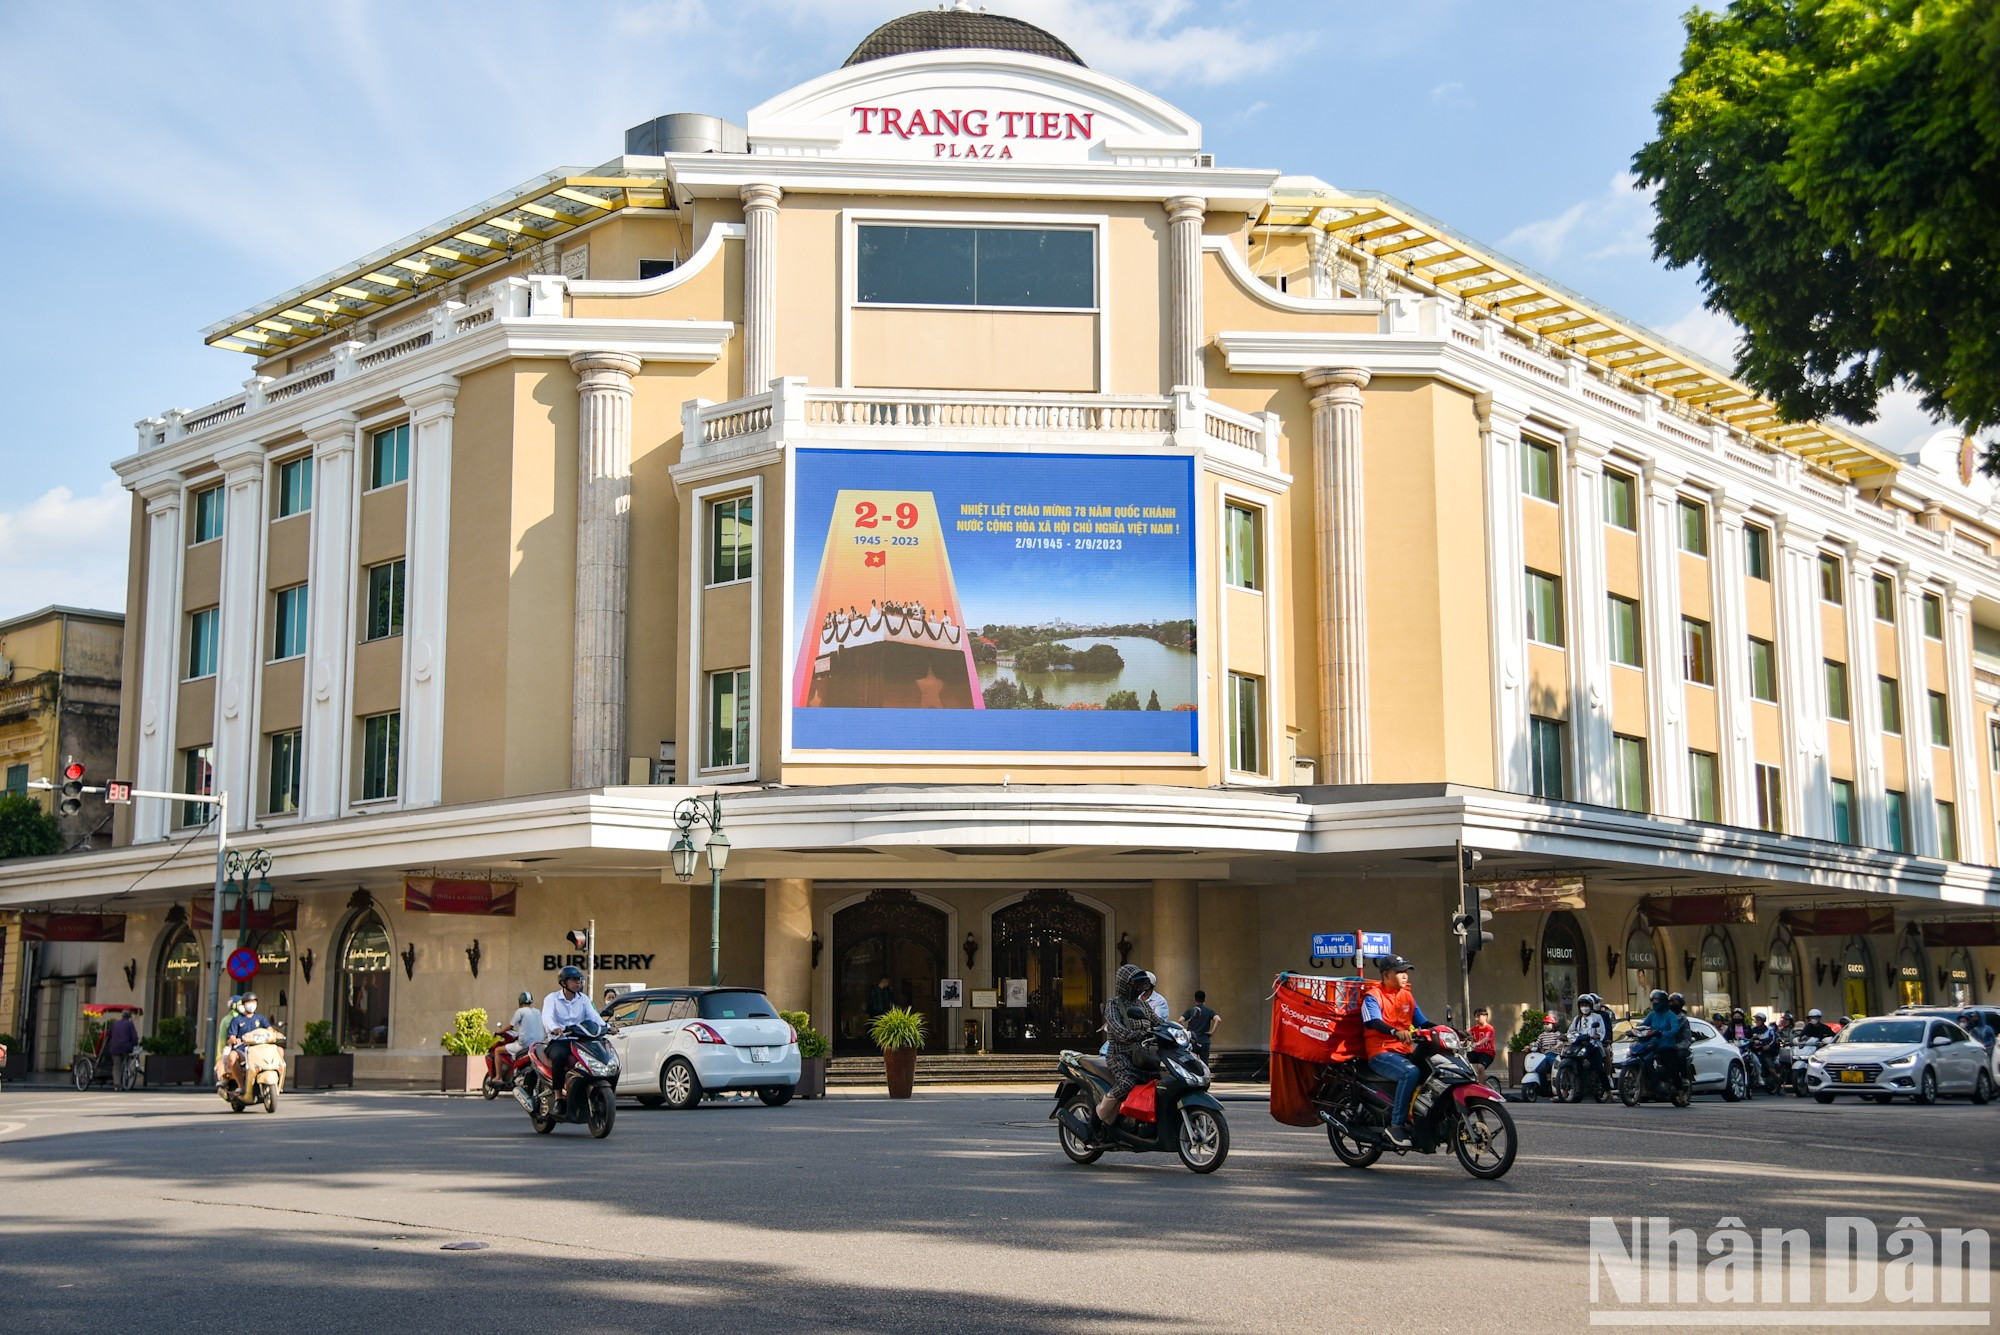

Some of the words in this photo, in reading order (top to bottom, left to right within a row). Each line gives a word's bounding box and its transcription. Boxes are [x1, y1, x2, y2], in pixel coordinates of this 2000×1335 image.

[852, 106, 989, 139] TRANG
[996, 111, 1094, 140] TIEN
[934, 143, 1013, 159] PLAZA
[960, 503, 989, 518] NHIỆT
[991, 503, 1012, 519] LIỆT
[1014, 503, 1040, 517] CHÀO
[1043, 504, 1072, 518] MỪNG
[1074, 506, 1087, 518] 78
[1114, 504, 1140, 519] QUỐC
[1142, 505, 1176, 518] KHÁNH
[956, 518, 984, 532] NƯỚC
[986, 520, 1013, 535] CỘNG
[1016, 520, 1036, 532] HÒA
[1038, 518, 1052, 532] XÃ
[1054, 520, 1071, 536] HỘI
[1072, 518, 1093, 534] CHỦ
[1094, 521, 1126, 534] NGHĨA
[1128, 522, 1148, 536] VIỆT
[1150, 523, 1174, 534] NAM
[854, 536, 881, 544] 1945
[892, 536, 919, 546] 2023
[1015, 538, 1063, 550] 2/9/1945
[1074, 539, 1123, 550] 2/9/2023
[1316, 944, 1338, 954] TRÀNG
[1546, 948, 1572, 958] HUBLOT
[1630, 952, 1652, 962] GUCCI
[1704, 957, 1724, 966] GUCCI
[1848, 964, 1864, 972] GUCCI
[1902, 967, 1918, 976] GUCCI
[1952, 970, 1967, 978] GUCCI
[1280, 1003, 1305, 1021] Shopee
